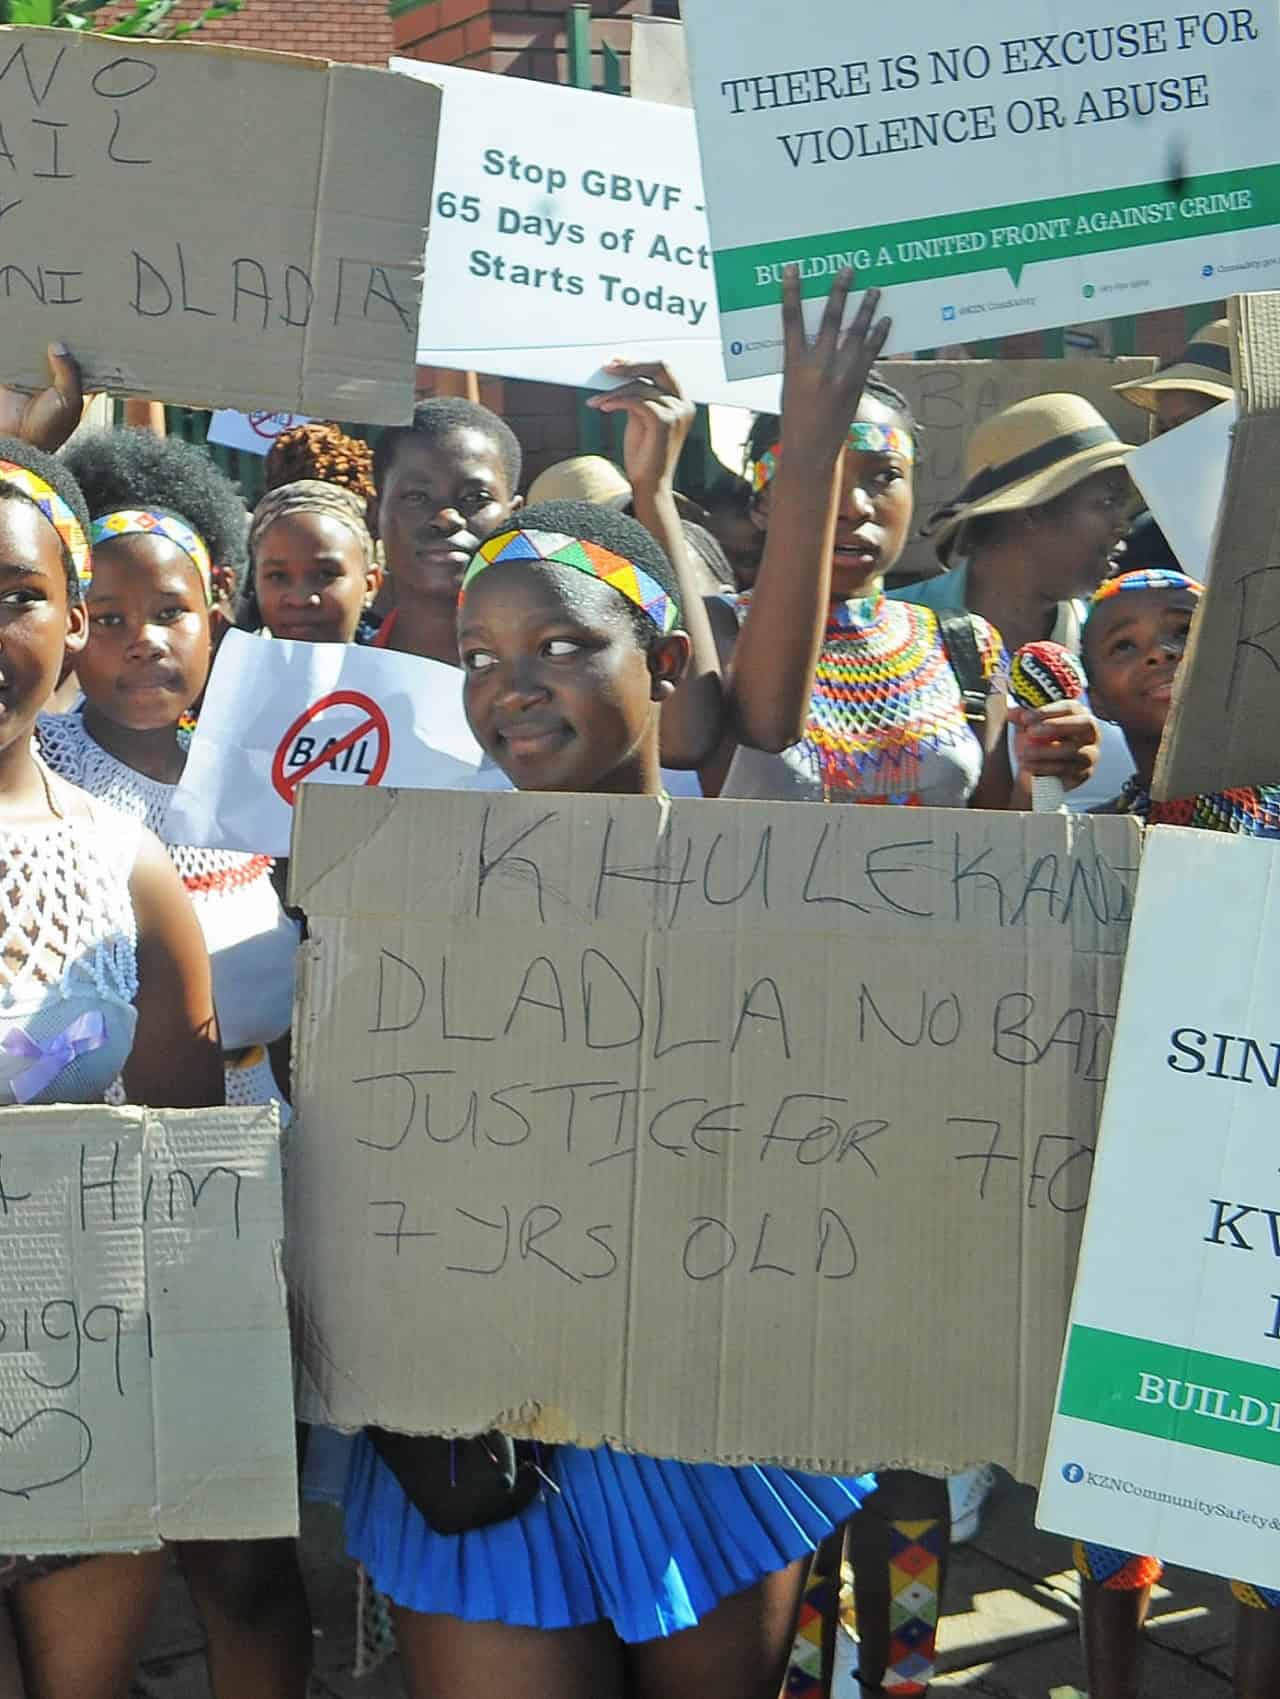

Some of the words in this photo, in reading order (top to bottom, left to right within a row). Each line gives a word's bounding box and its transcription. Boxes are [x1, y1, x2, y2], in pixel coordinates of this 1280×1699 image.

[721, 61, 871, 115] THERE
[875, 54, 918, 93] IS
[928, 45, 990, 87] NO
[1002, 21, 1167, 75] EXCUSE
[1175, 7, 1259, 51] FOR
[778, 102, 998, 169] VIOLENCE
[1006, 94, 1065, 134] OR
[1074, 75, 1211, 124] ABUSE
[482, 148, 567, 194] Stop
[581, 168, 682, 212] GBVF
[497, 206, 585, 246] Days
[599, 228, 635, 254] of
[647, 234, 711, 270] Act
[753, 249, 873, 287] BUILDING
[875, 246, 893, 267] A
[897, 230, 987, 263] UNITED
[989, 215, 1071, 250] FRONT
[1074, 199, 1176, 238] AGAINST
[1179, 189, 1253, 220] CRIME
[468, 250, 585, 296] Starts
[598, 273, 708, 326] Today
[288, 737, 371, 775] BAIL
[368, 948, 791, 1061] DLADLA
[859, 982, 963, 1048] NO
[992, 992, 1117, 1083] BAI
[354, 1069, 746, 1167] JUSTICE
[761, 1092, 888, 1178] FOR
[1027, 1133, 1095, 1213] FO
[369, 1200, 436, 1256] 7
[445, 1203, 620, 1284] YRS
[682, 1206, 859, 1280] OLD
[1136, 1372, 1280, 1433] BUILDI
